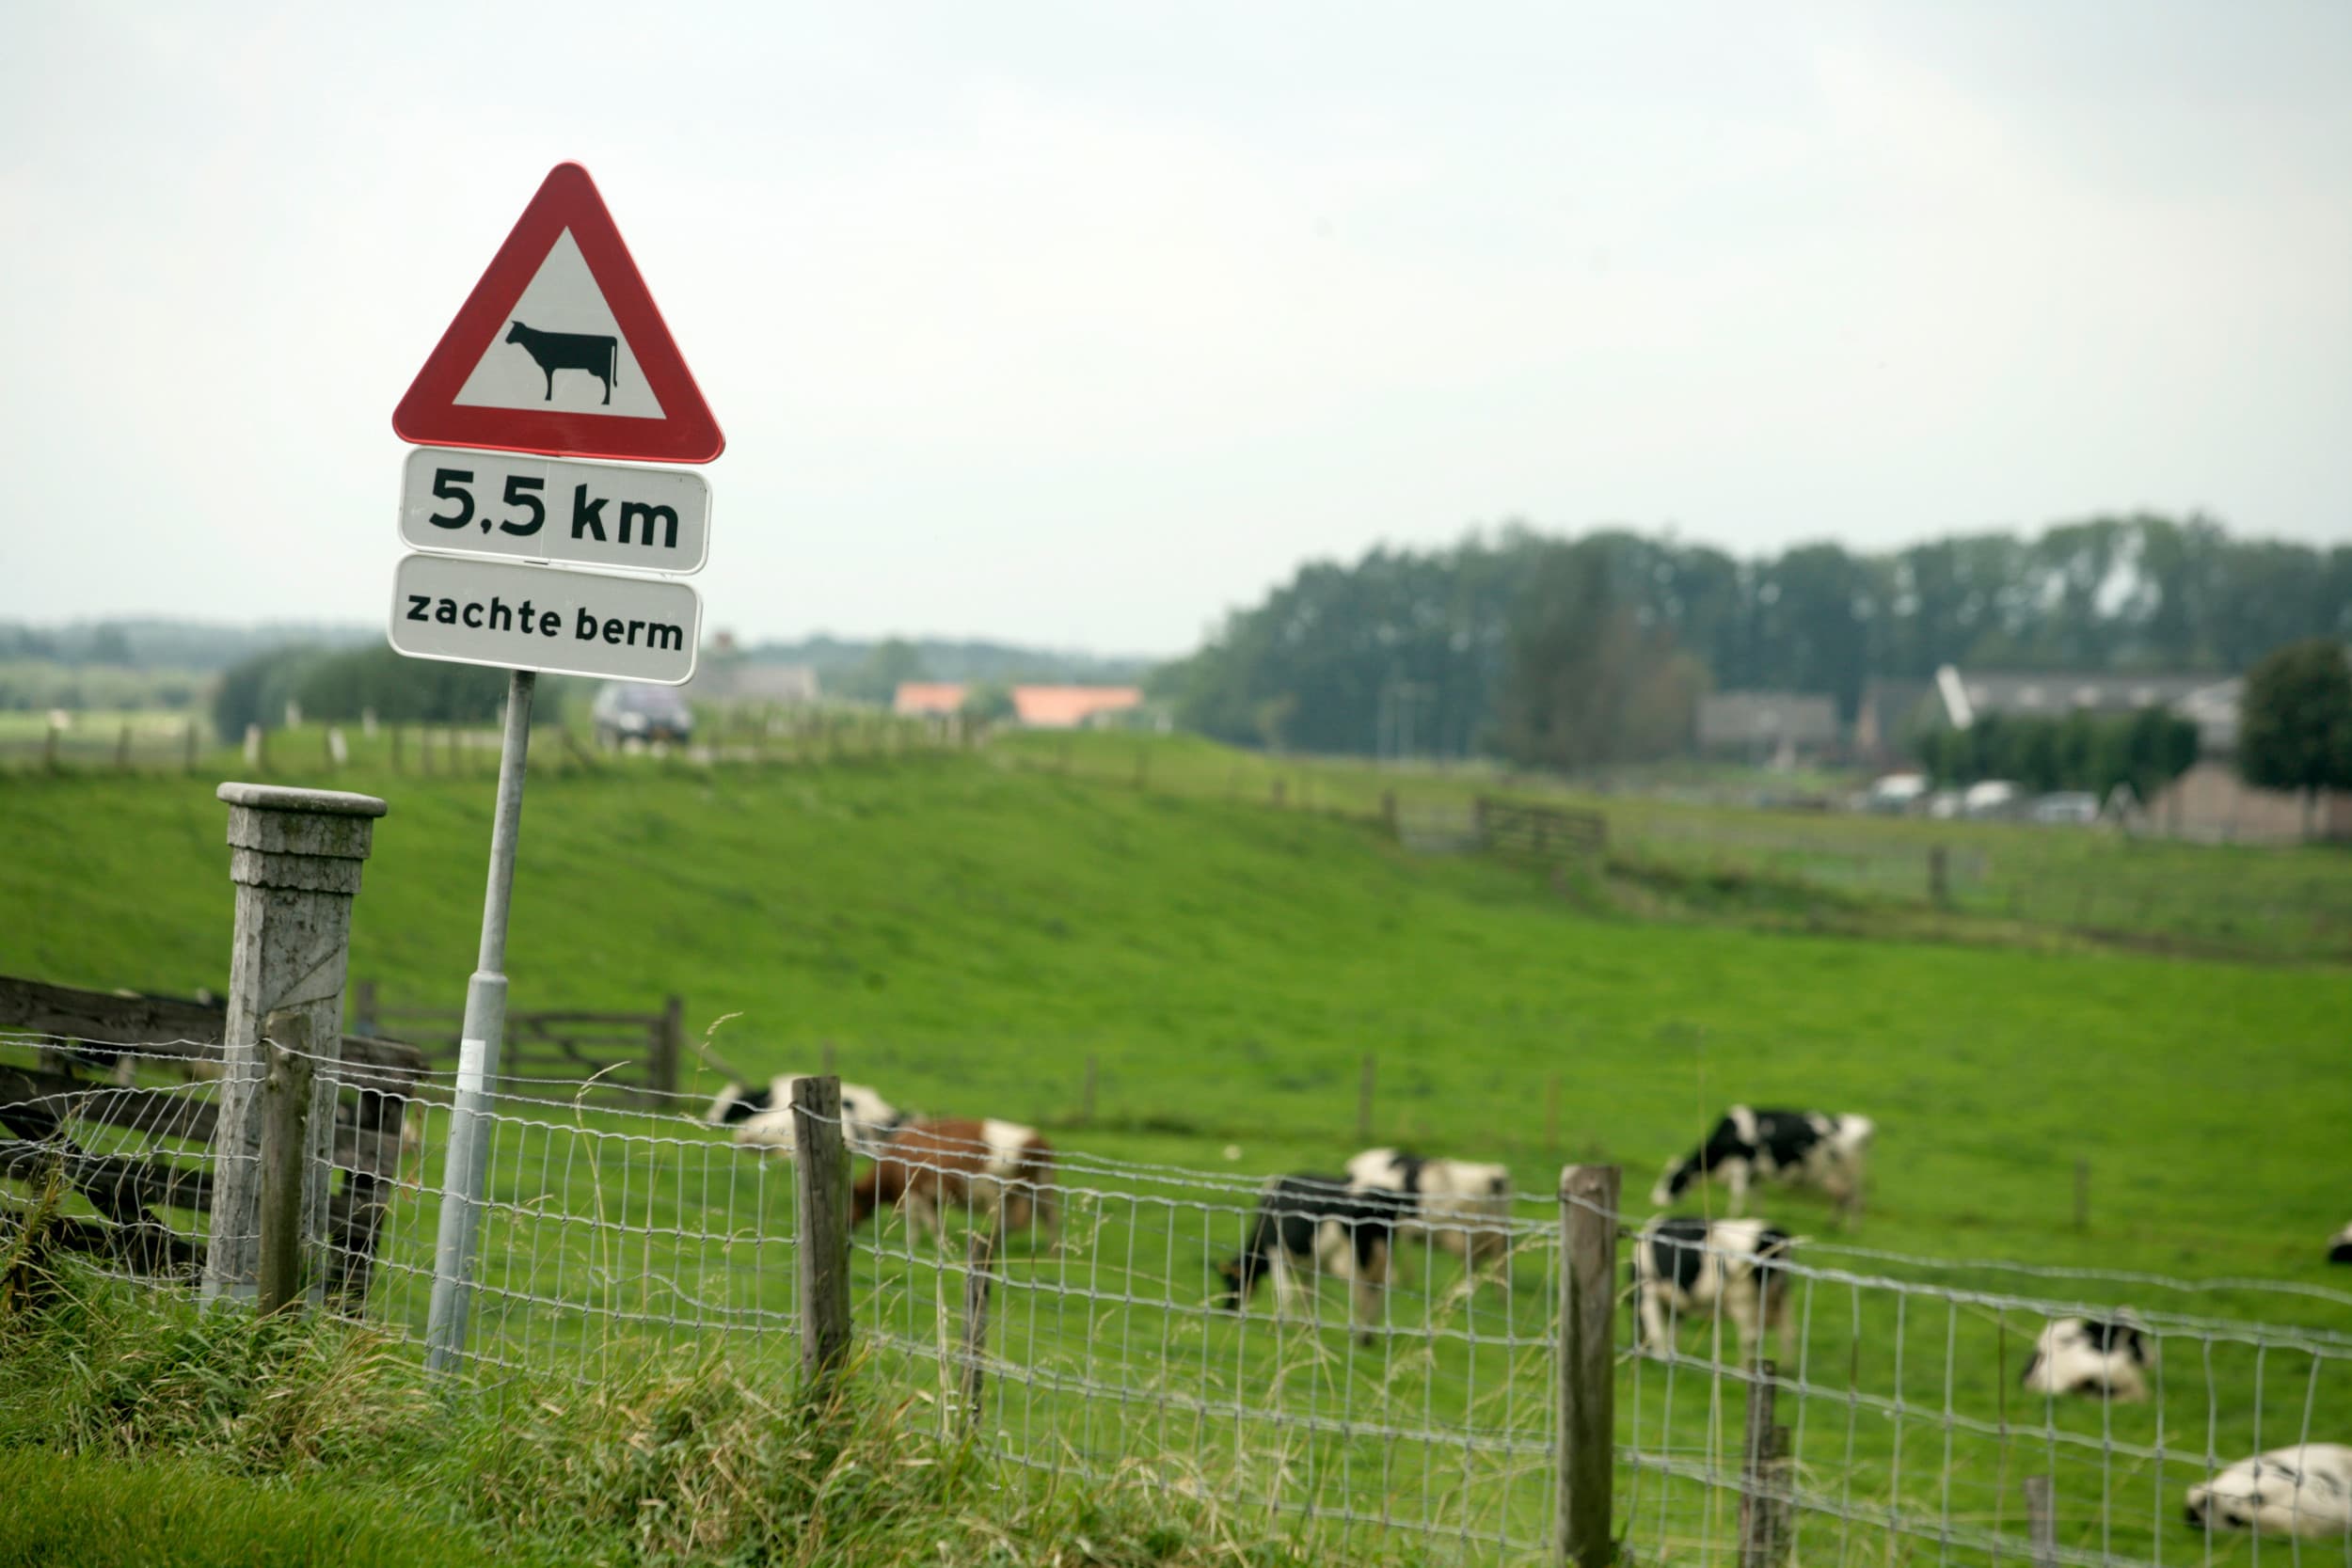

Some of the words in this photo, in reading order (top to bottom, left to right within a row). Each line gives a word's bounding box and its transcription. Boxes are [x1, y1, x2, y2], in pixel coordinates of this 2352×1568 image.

[428, 467, 546, 537] 5,5
[571, 483, 679, 548] km
[406, 594, 562, 637] zachte
[575, 607, 684, 651] berm
